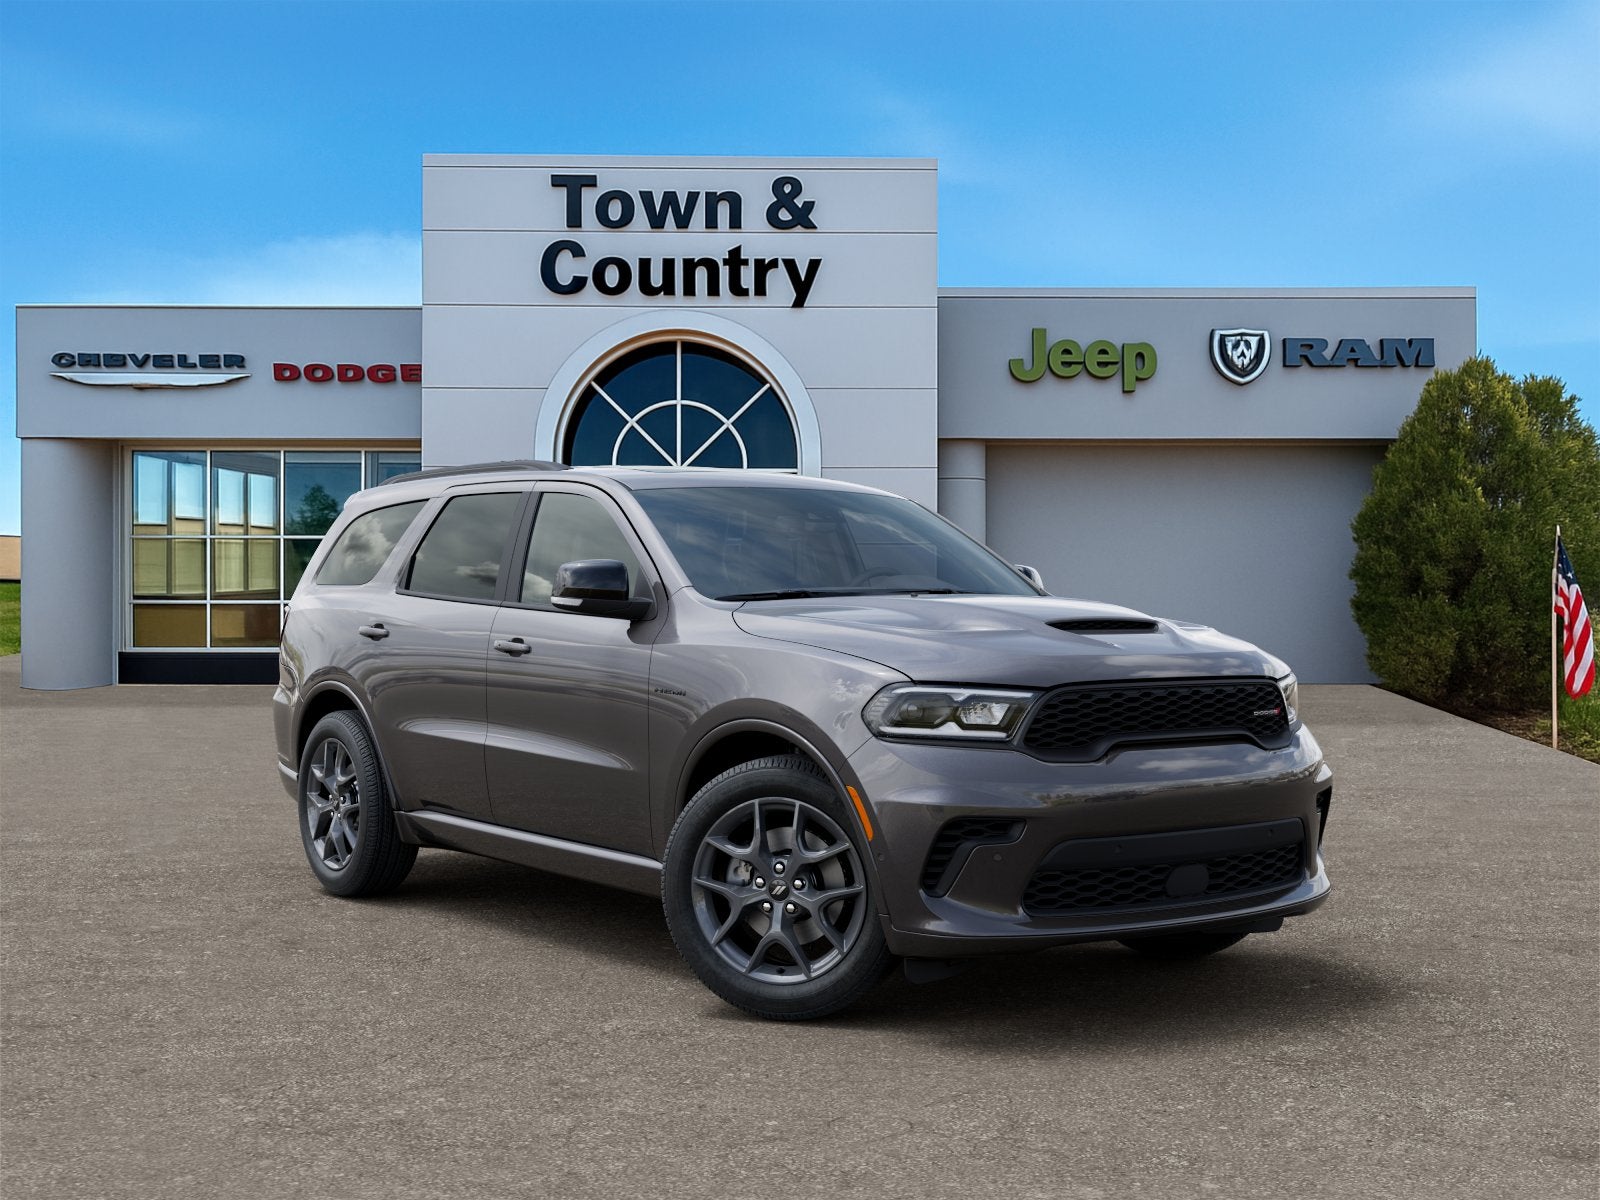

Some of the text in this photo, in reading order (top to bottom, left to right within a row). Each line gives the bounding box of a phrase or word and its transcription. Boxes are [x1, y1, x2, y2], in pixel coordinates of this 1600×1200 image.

[550, 174, 818, 230] Town &
[540, 239, 822, 308] Country
[273, 363, 422, 383] DODGE
[1008, 327, 1158, 393] Jeep
[1282, 337, 1435, 368] RAM
